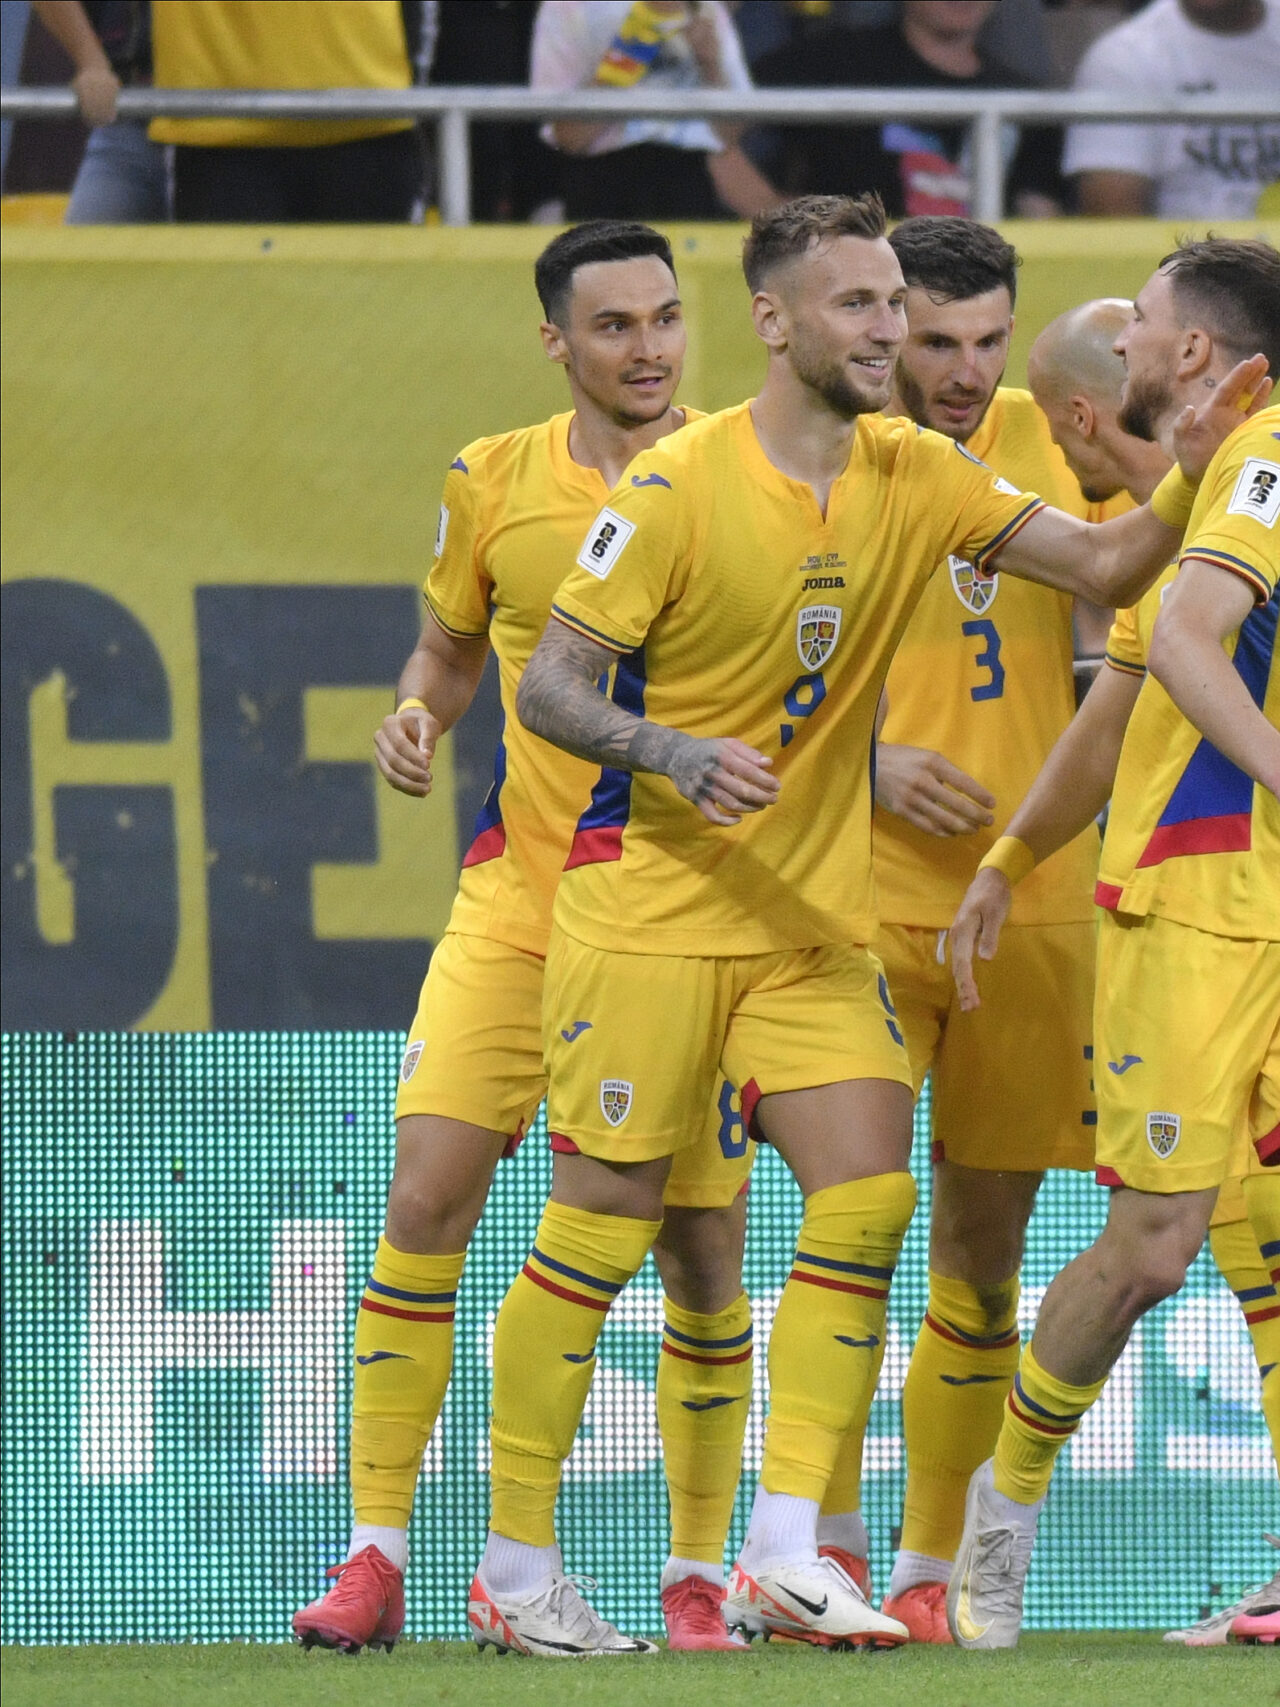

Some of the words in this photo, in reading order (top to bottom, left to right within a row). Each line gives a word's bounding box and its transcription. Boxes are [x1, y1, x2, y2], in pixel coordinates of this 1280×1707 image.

[962, 619, 1005, 702] 3
[780, 671, 828, 748] 9
[718, 1080, 748, 1159] 8
